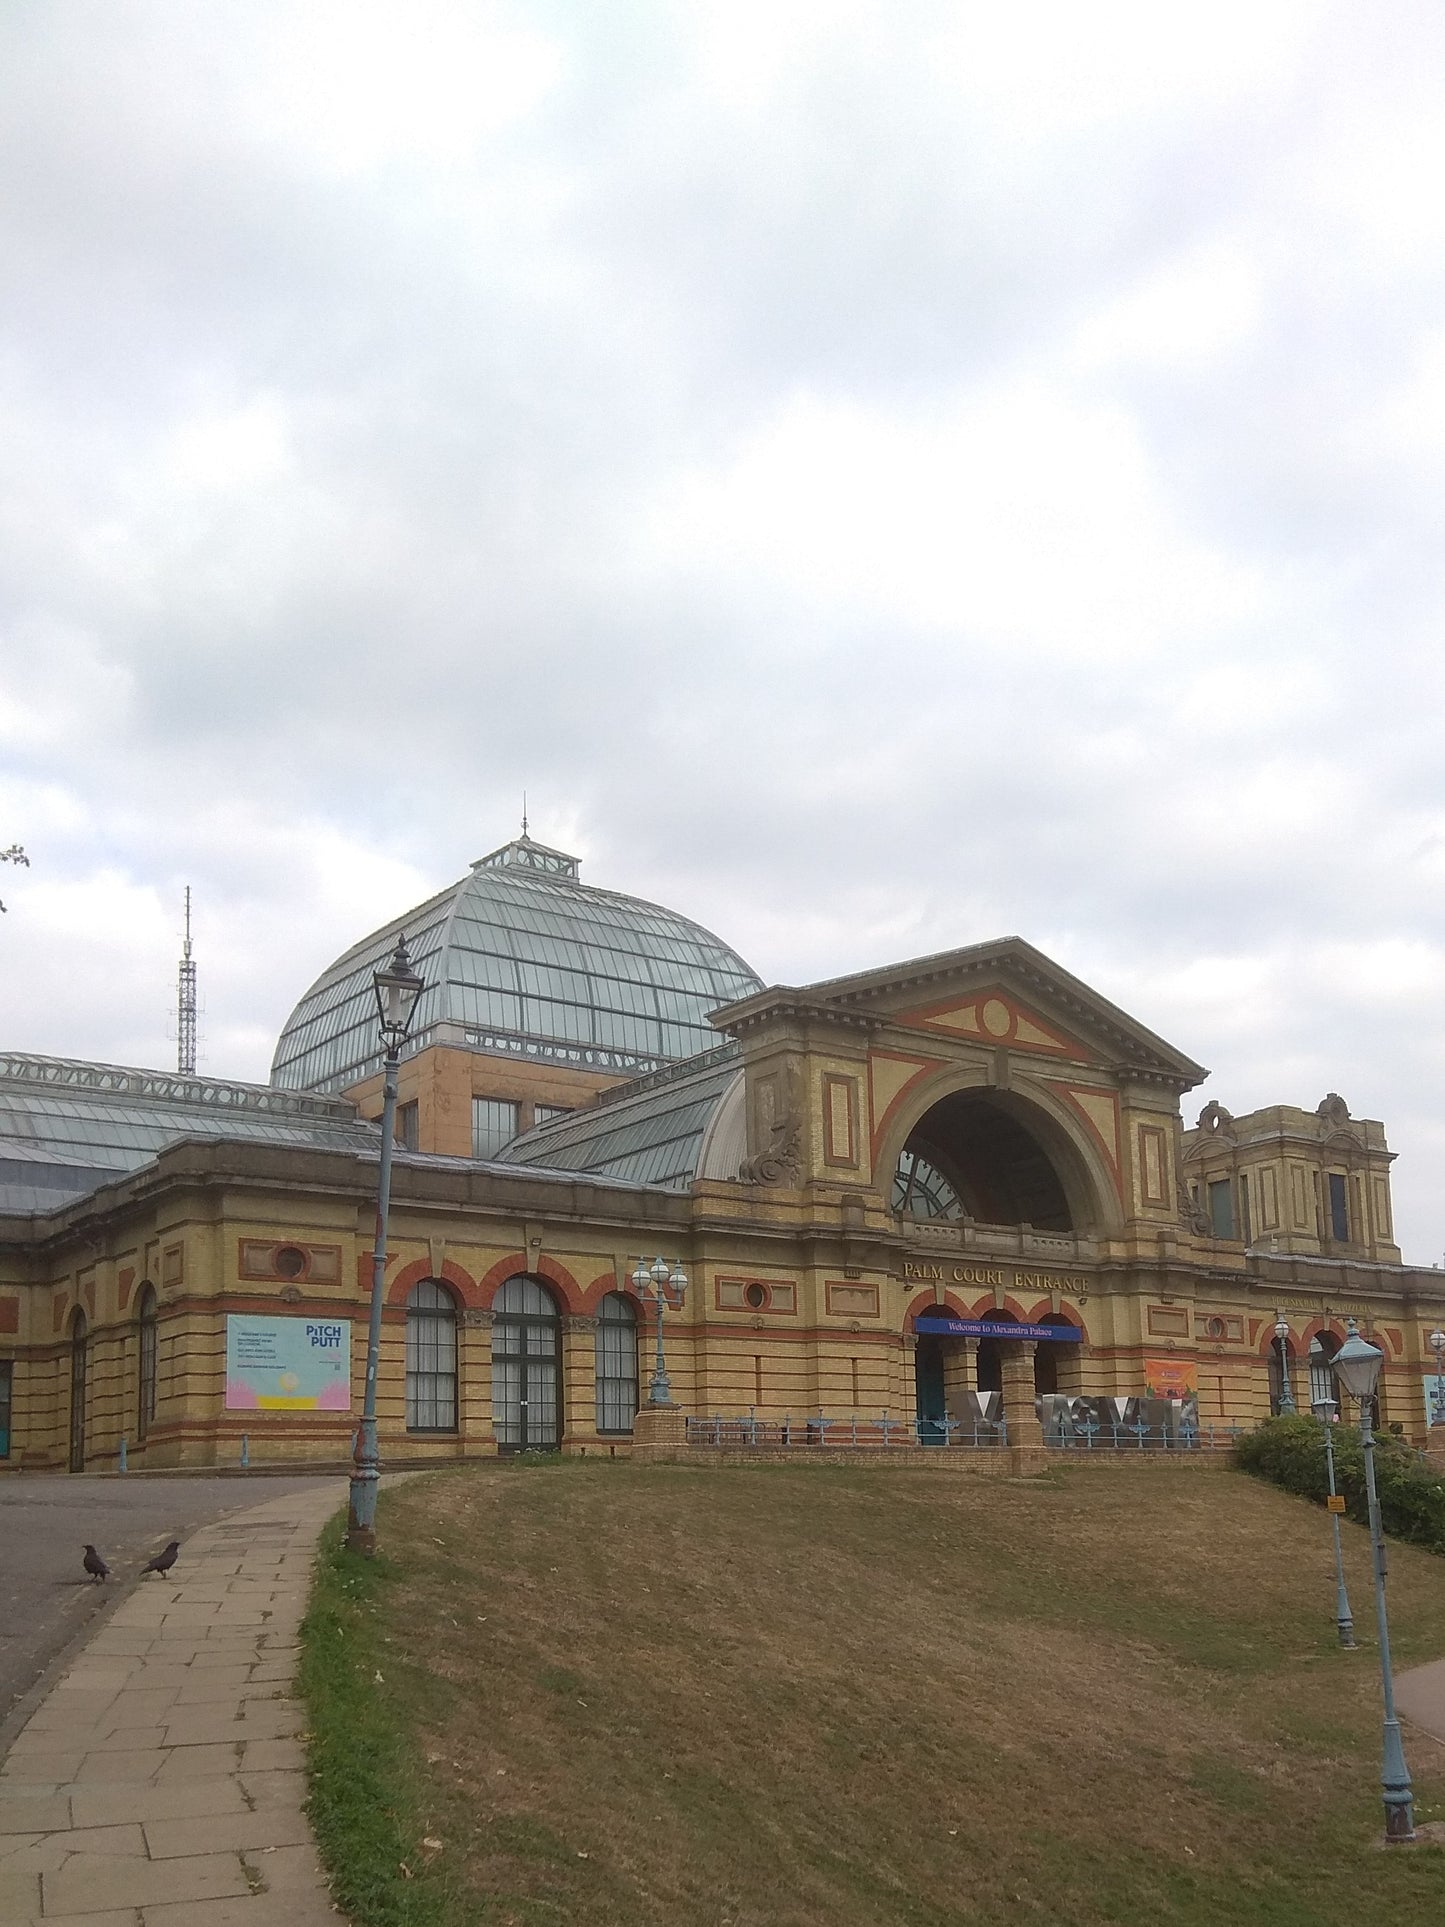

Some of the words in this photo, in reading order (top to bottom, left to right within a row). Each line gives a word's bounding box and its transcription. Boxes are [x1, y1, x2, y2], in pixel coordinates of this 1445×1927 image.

[904, 1262, 944, 1280] PALM
[953, 1267, 1004, 1285] COURT
[1015, 1272, 1090, 1292] ENTRANCE
[948, 1321, 981, 1333] Welcome
[982, 1323, 990, 1333] to
[991, 1325, 1029, 1335] Alexandra
[1029, 1326, 1052, 1336] Palace
[311, 1336, 341, 1348] PUTT
